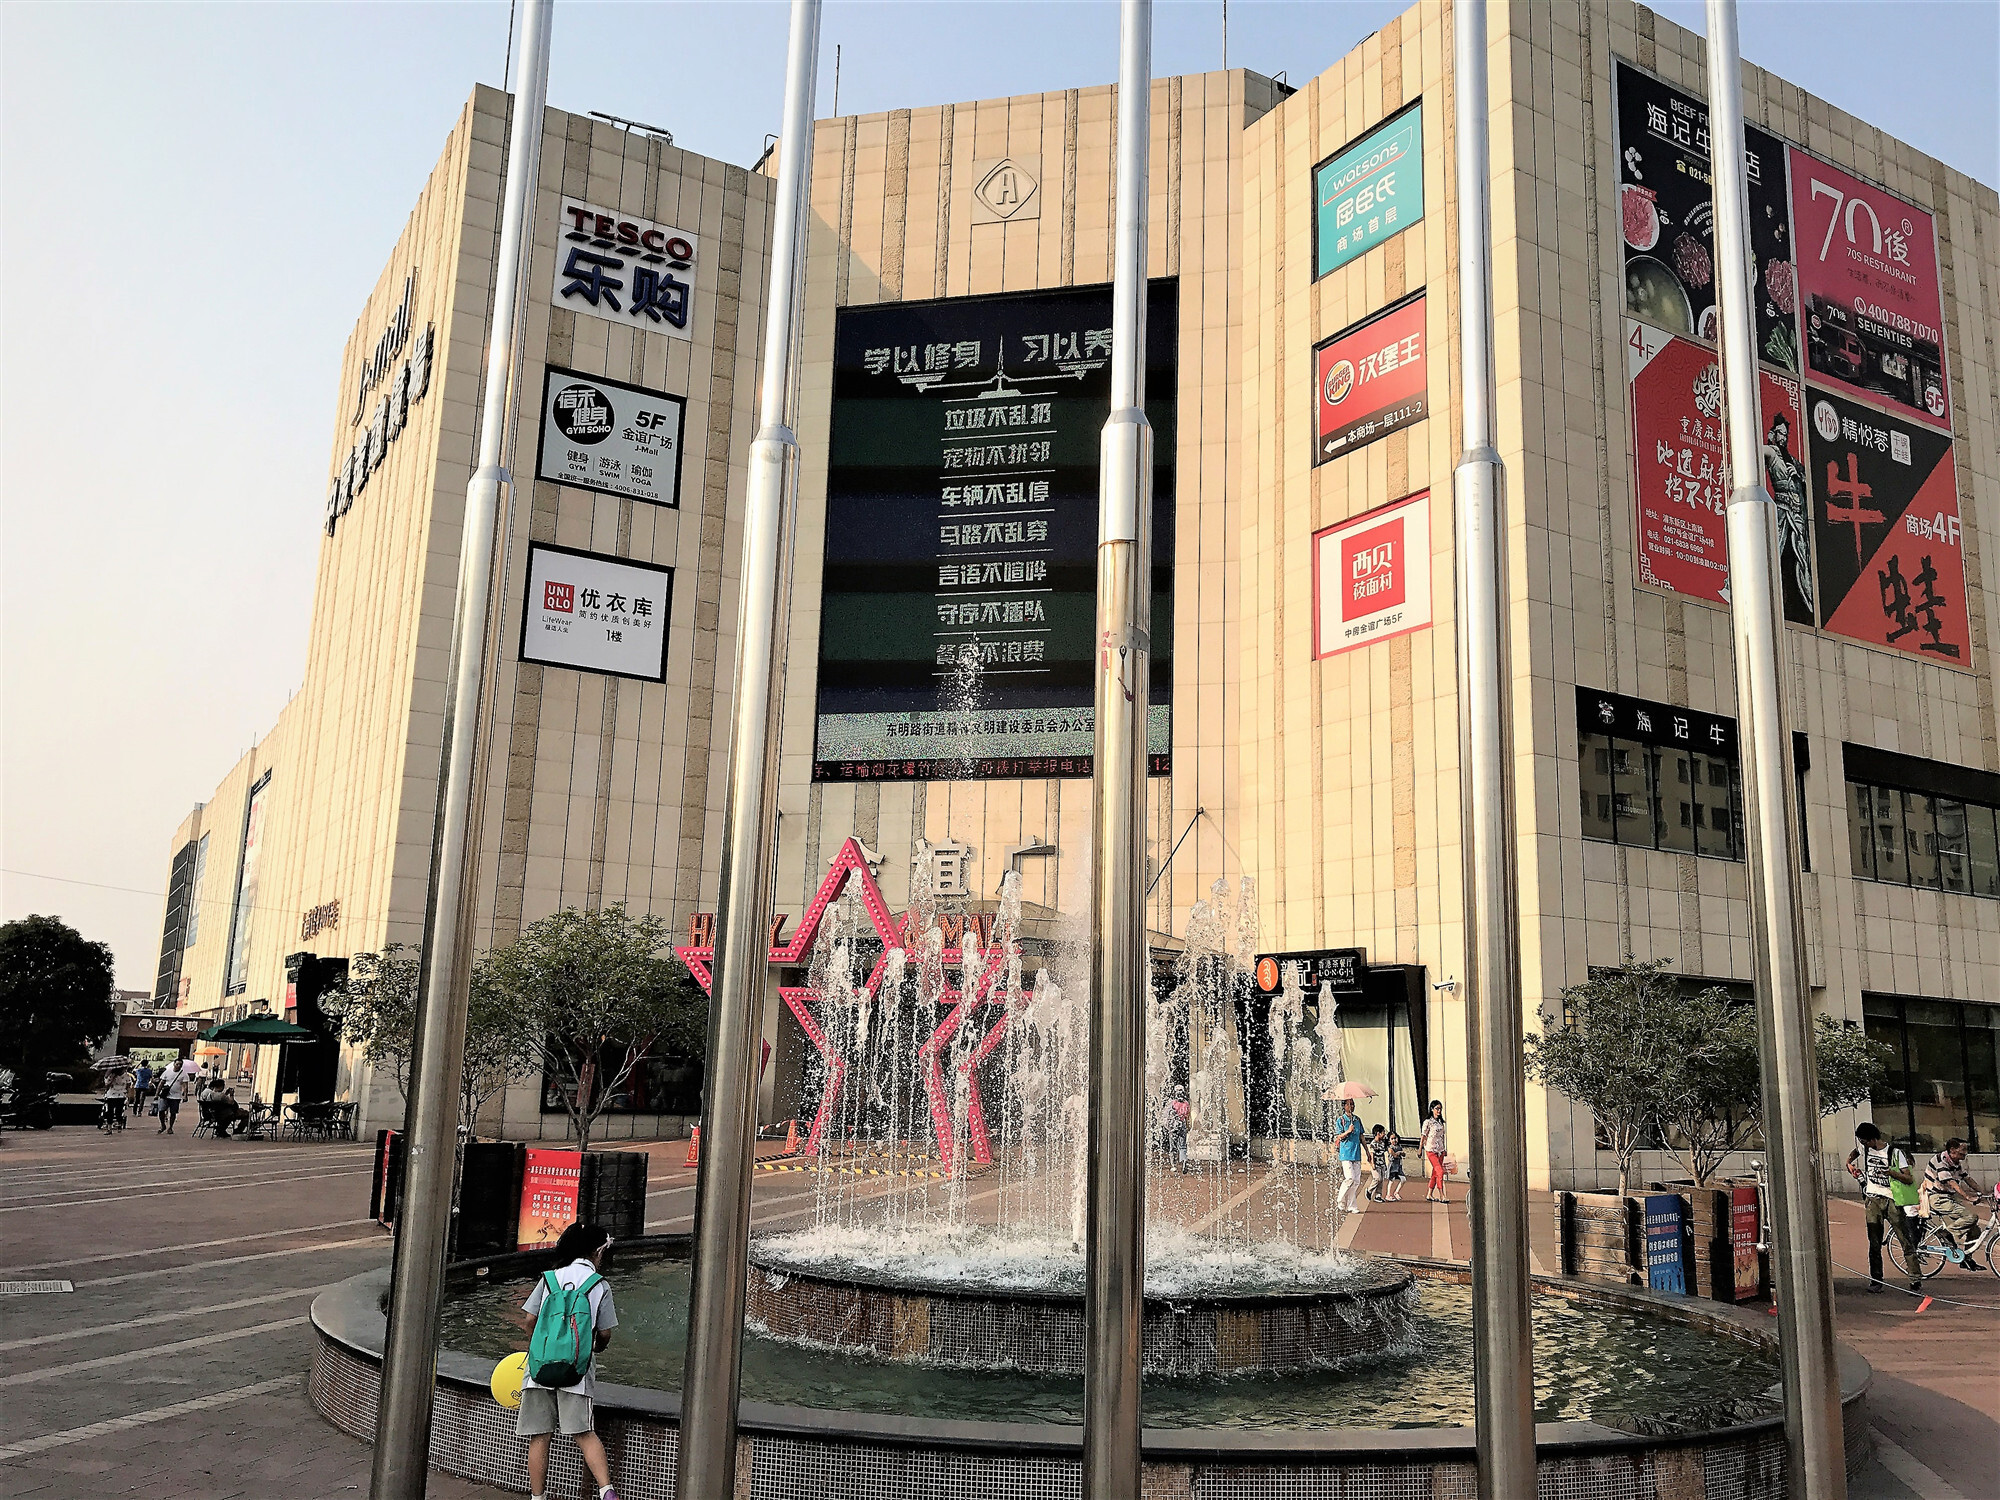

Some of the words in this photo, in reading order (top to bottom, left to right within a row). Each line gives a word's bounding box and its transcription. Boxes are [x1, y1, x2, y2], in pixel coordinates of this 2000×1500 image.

[1670, 98, 1697, 119] BEEF
[1647, 102, 1760, 178] 海记牛店
[1333, 141, 1398, 191] watsons
[1336, 171, 1395, 229] 屈臣氏
[567, 206, 693, 260] TESCO
[1336, 206, 1397, 253] 商场首层
[1847, 247, 1862, 262] 70S
[1864, 254, 1917, 286] RESTAURANT
[560, 246, 689, 329] 乐购
[1629, 324, 1655, 360] 4F
[1857, 316, 1913, 348] SEVENTIES
[864, 340, 981, 375] 学以修身
[1358, 332, 1421, 386] 汉堡王
[1328, 364, 1350, 389] BURGER
[1328, 372, 1351, 398] KING
[1926, 390, 1944, 410] 5F
[572, 406, 607, 426] 健身
[635, 410, 667, 430] 5F
[944, 403, 1051, 430] 垃圾不乱扔
[1347, 401, 1422, 443] 本商场一层111-2
[566, 426, 586, 435] GYM
[586, 425, 612, 434] SOHO
[622, 427, 673, 449] 金谊广场
[635, 445, 659, 456] J-Mall
[943, 441, 1050, 469] 宠物不扰邻
[567, 450, 589, 464] 健身
[599, 456, 621, 471] 游泳
[631, 464, 653, 478] 瑜伽
[569, 463, 586, 472] GYM
[599, 470, 620, 480] SWIM
[631, 477, 652, 486] YOGA
[941, 481, 1049, 507] 车辆不乱停
[1825, 452, 1887, 573] 牛
[940, 521, 1048, 546] 马路不乱穿
[1905, 511, 1960, 545] 商场4F
[938, 560, 1047, 586] 言语不喧哗
[1353, 541, 1393, 579] 西贝
[548, 585, 569, 598] UNI
[1353, 571, 1393, 601] 莜面村
[547, 596, 571, 609] QLO
[580, 588, 653, 618] 优衣库
[937, 600, 1046, 625] 守序不插队
[1878, 554, 1960, 659] 蛙
[542, 615, 572, 626] LifeWear
[578, 609, 652, 629] 简约优质创美好
[1345, 612, 1403, 638] 中房金谊广场5F
[606, 629, 622, 642] 1楼
[156, 1019, 199, 1032] 留夫鸭
